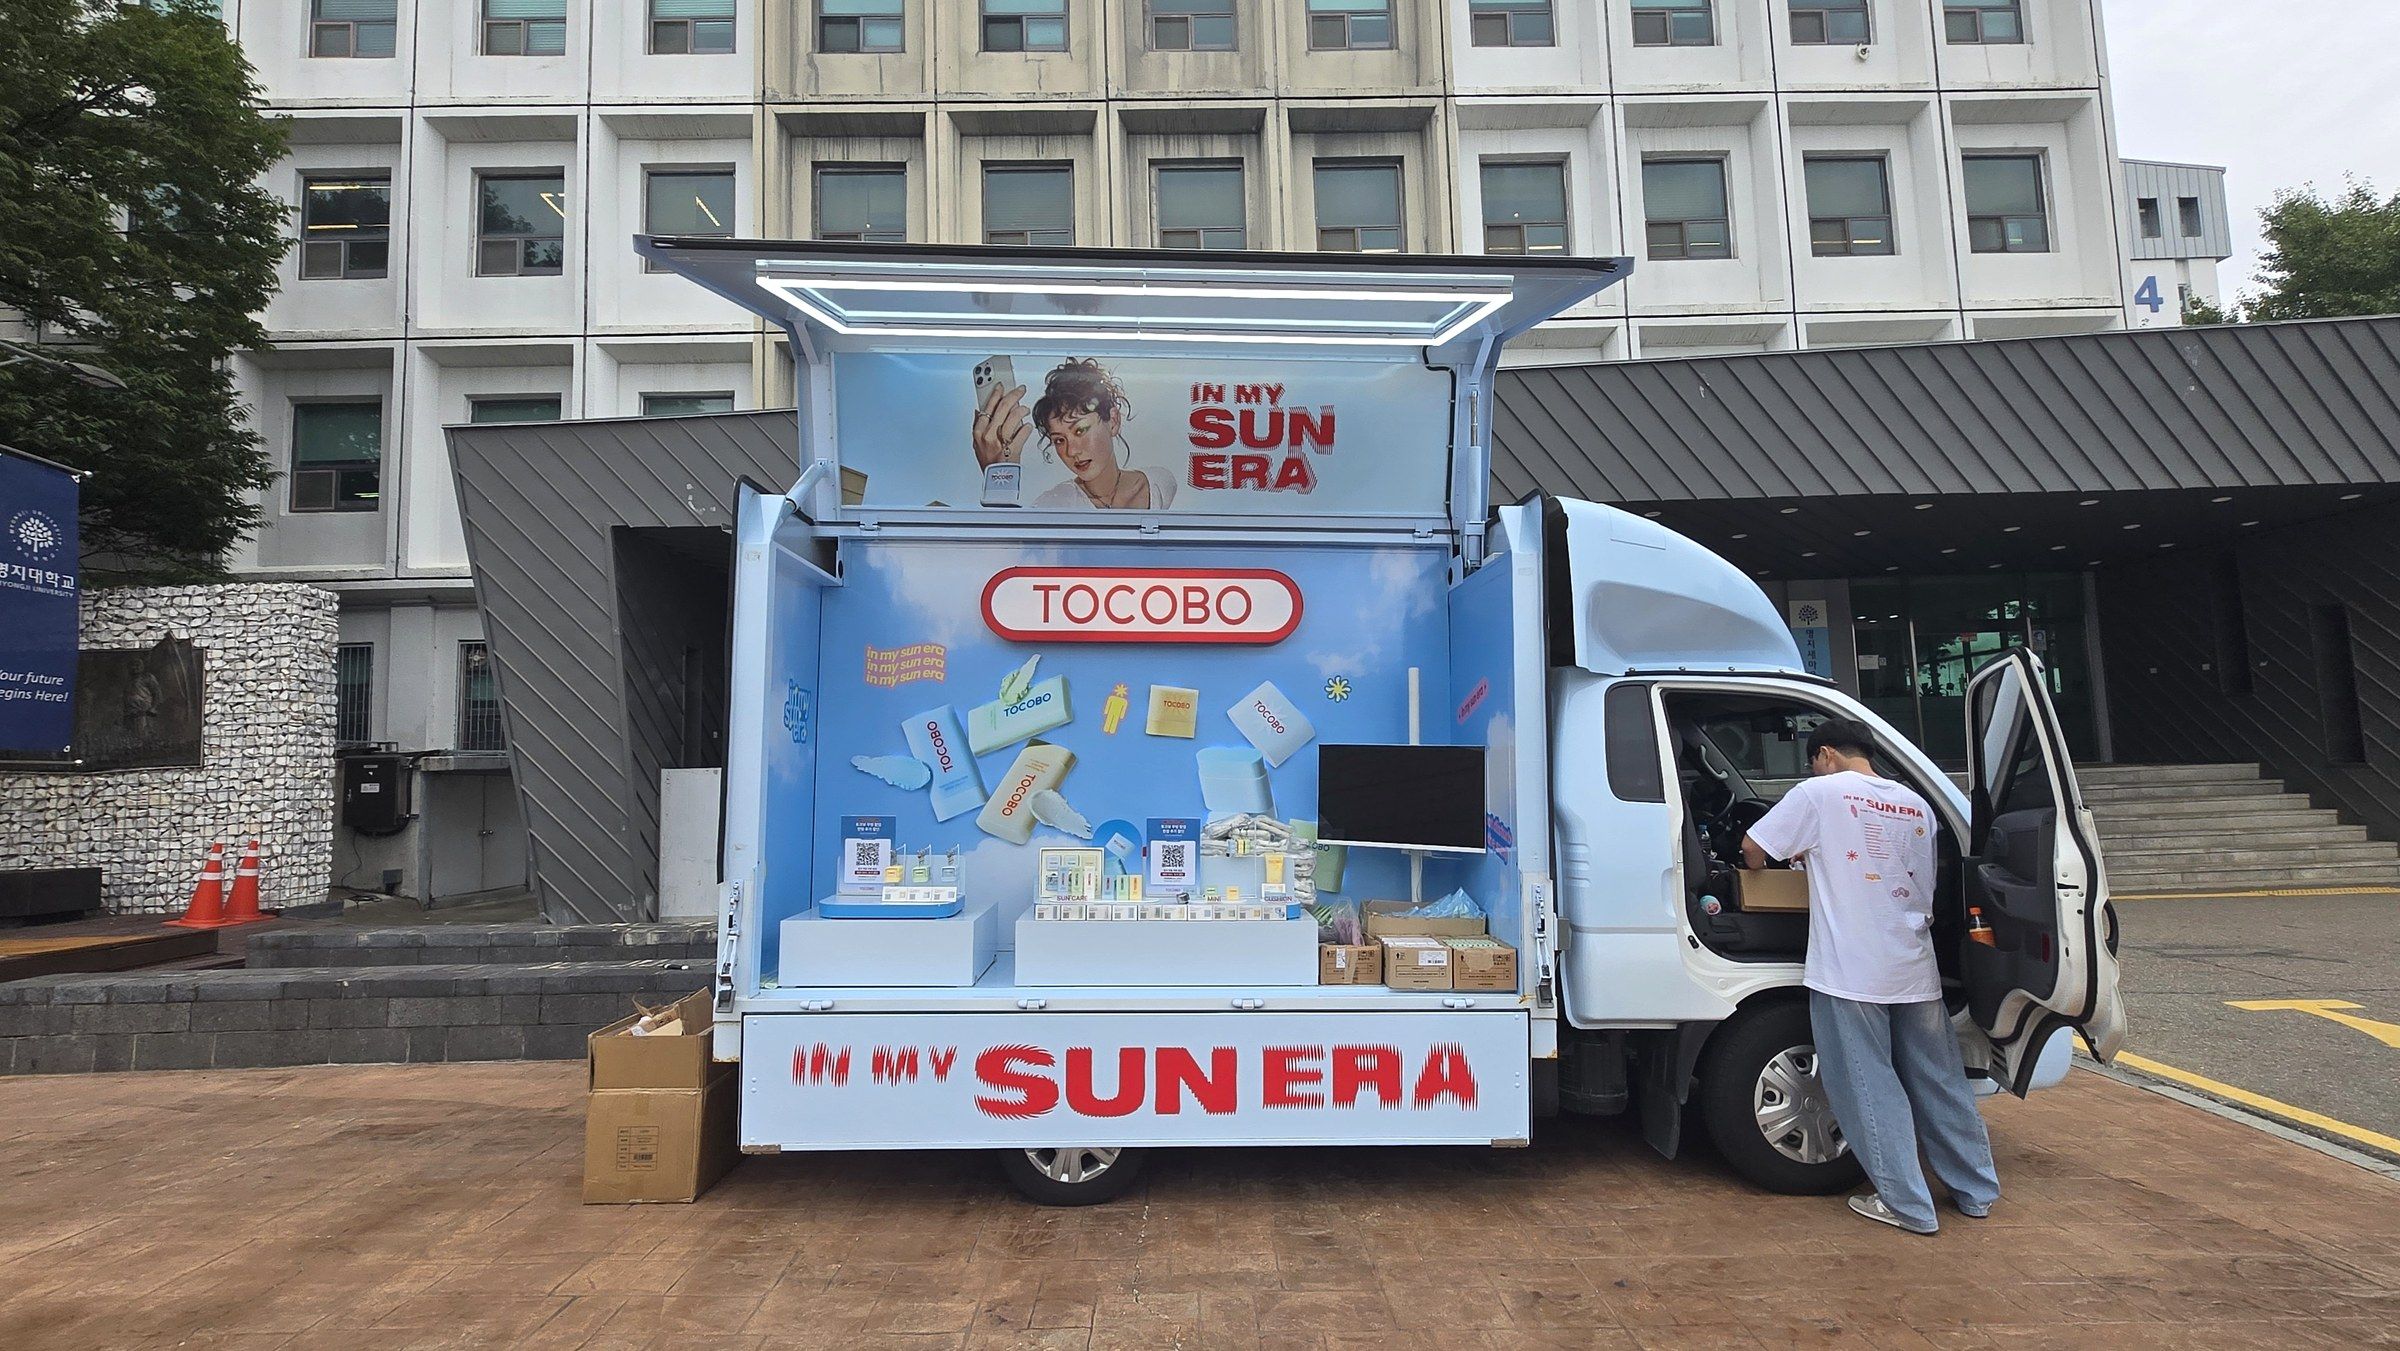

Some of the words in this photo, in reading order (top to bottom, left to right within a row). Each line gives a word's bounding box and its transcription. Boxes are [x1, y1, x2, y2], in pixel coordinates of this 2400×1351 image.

[2134, 275, 2164, 313] 4
[1190, 382, 1226, 404] IN
[1234, 382, 1285, 405] MY
[1188, 405, 1335, 455] SUN
[1187, 452, 1318, 495] ERA
[0, 562, 75, 590] 명지대학교
[32, 586, 74, 598] UNIVERSITY
[1032, 584, 1252, 626] TOCOBO
[866, 646, 878, 660] in
[880, 650, 900, 662] my
[900, 646, 921, 657] sun
[923, 644, 945, 656] era
[1805, 629, 1817, 674] 명지새마
[24, 671, 64, 686] future
[866, 659, 878, 672] in
[880, 662, 899, 675] my
[900, 658, 921, 670] sun
[923, 657, 945, 668] era
[866, 671, 877, 685] in
[880, 674, 899, 687] my
[900, 670, 920, 682] sun
[923, 669, 945, 681] era
[0, 688, 32, 701] egins
[34, 690, 69, 703] Here!
[1003, 692, 1052, 717] TOCOBO
[1163, 700, 1190, 710] TOCOBO
[1253, 700, 1285, 734] TOCOBO
[926, 721, 953, 773] TOCOBO
[1002, 774, 1036, 817] TOCOBO
[1866, 799, 1897, 814] SUN
[1899, 806, 1924, 819] ERA
[791, 1042, 851, 1087] IN
[871, 1043, 958, 1087] MY
[973, 1043, 1238, 1121] SUN
[1262, 1042, 1479, 1113] ERA
